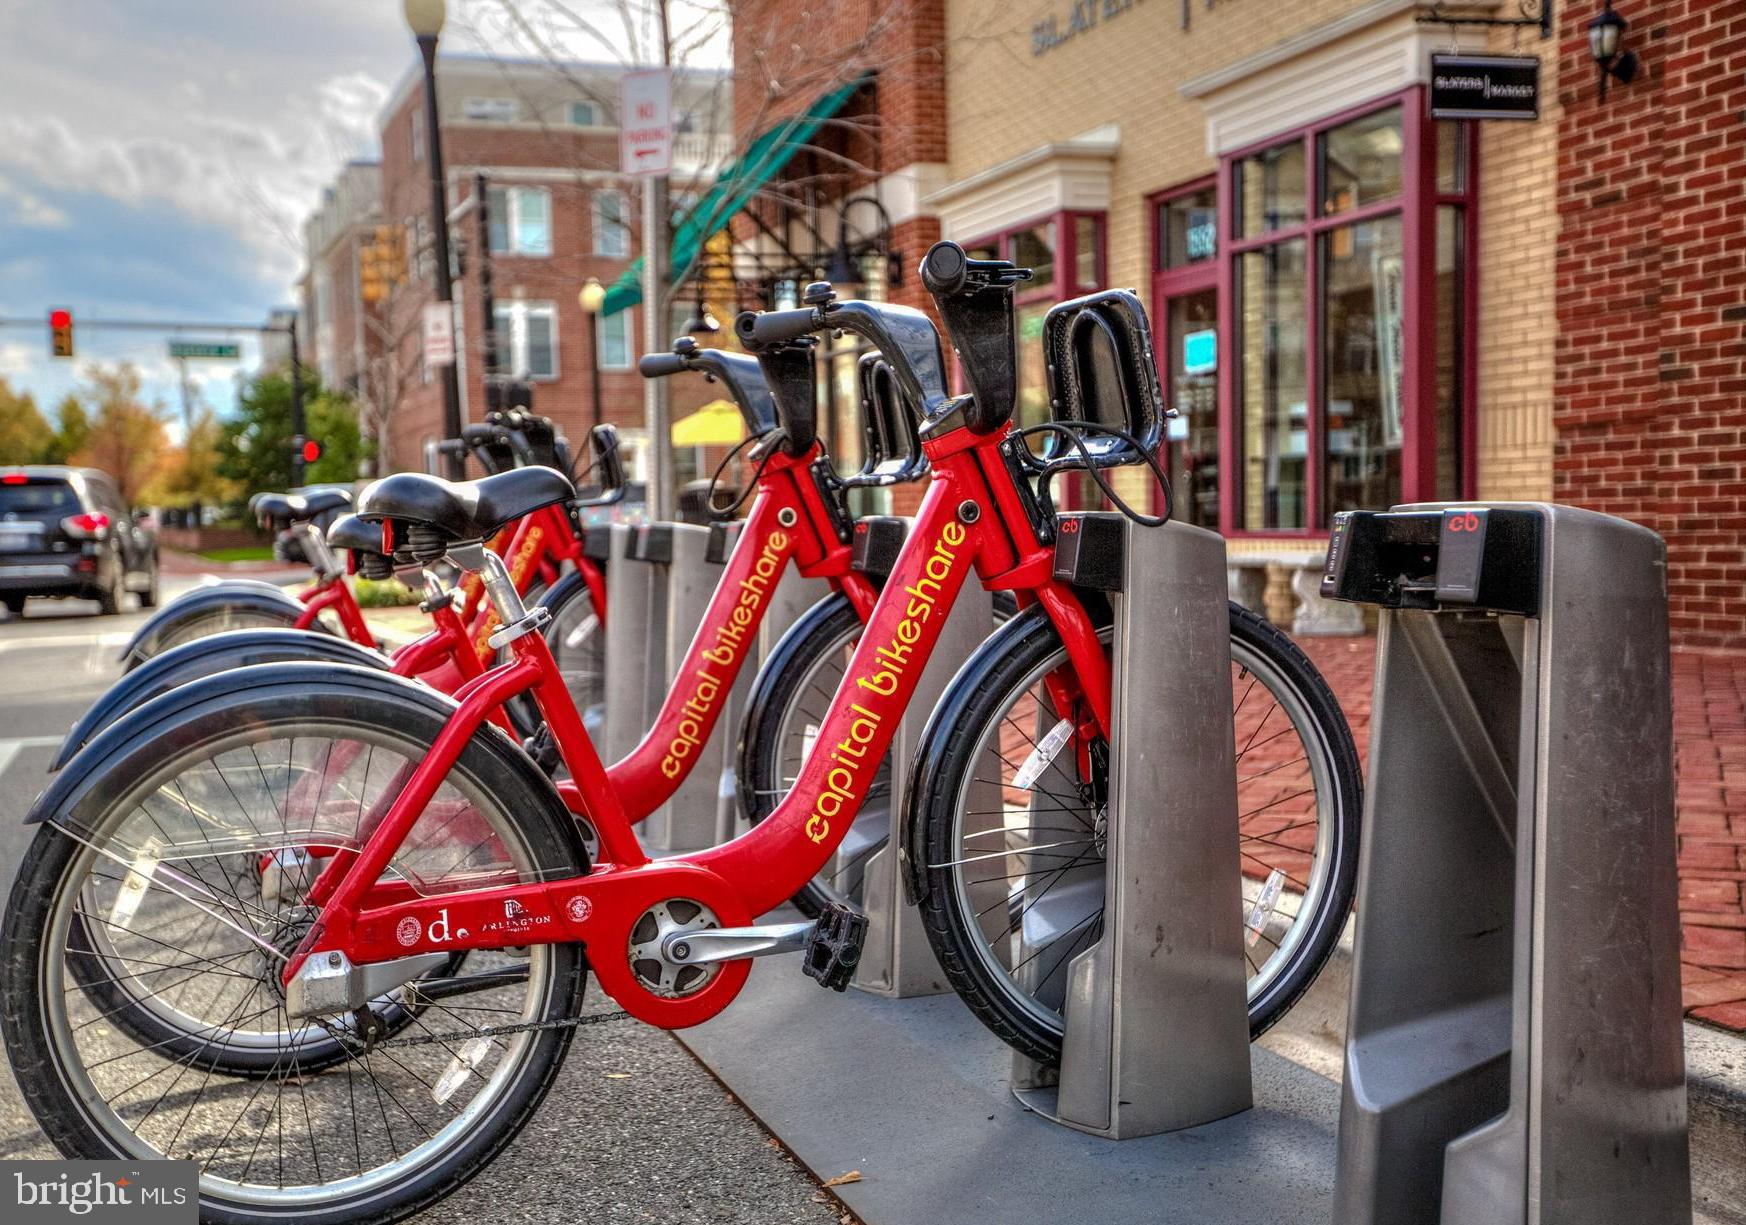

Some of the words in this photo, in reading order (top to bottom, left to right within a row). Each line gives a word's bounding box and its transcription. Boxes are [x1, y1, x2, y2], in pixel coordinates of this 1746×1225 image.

[636, 102, 656, 120] NO
[1491, 84, 1534, 97] MARKET
[661, 670, 722, 780] capital
[702, 530, 788, 666] bikeshare
[805, 703, 882, 845] capital
[856, 521, 966, 697] bikeshare
